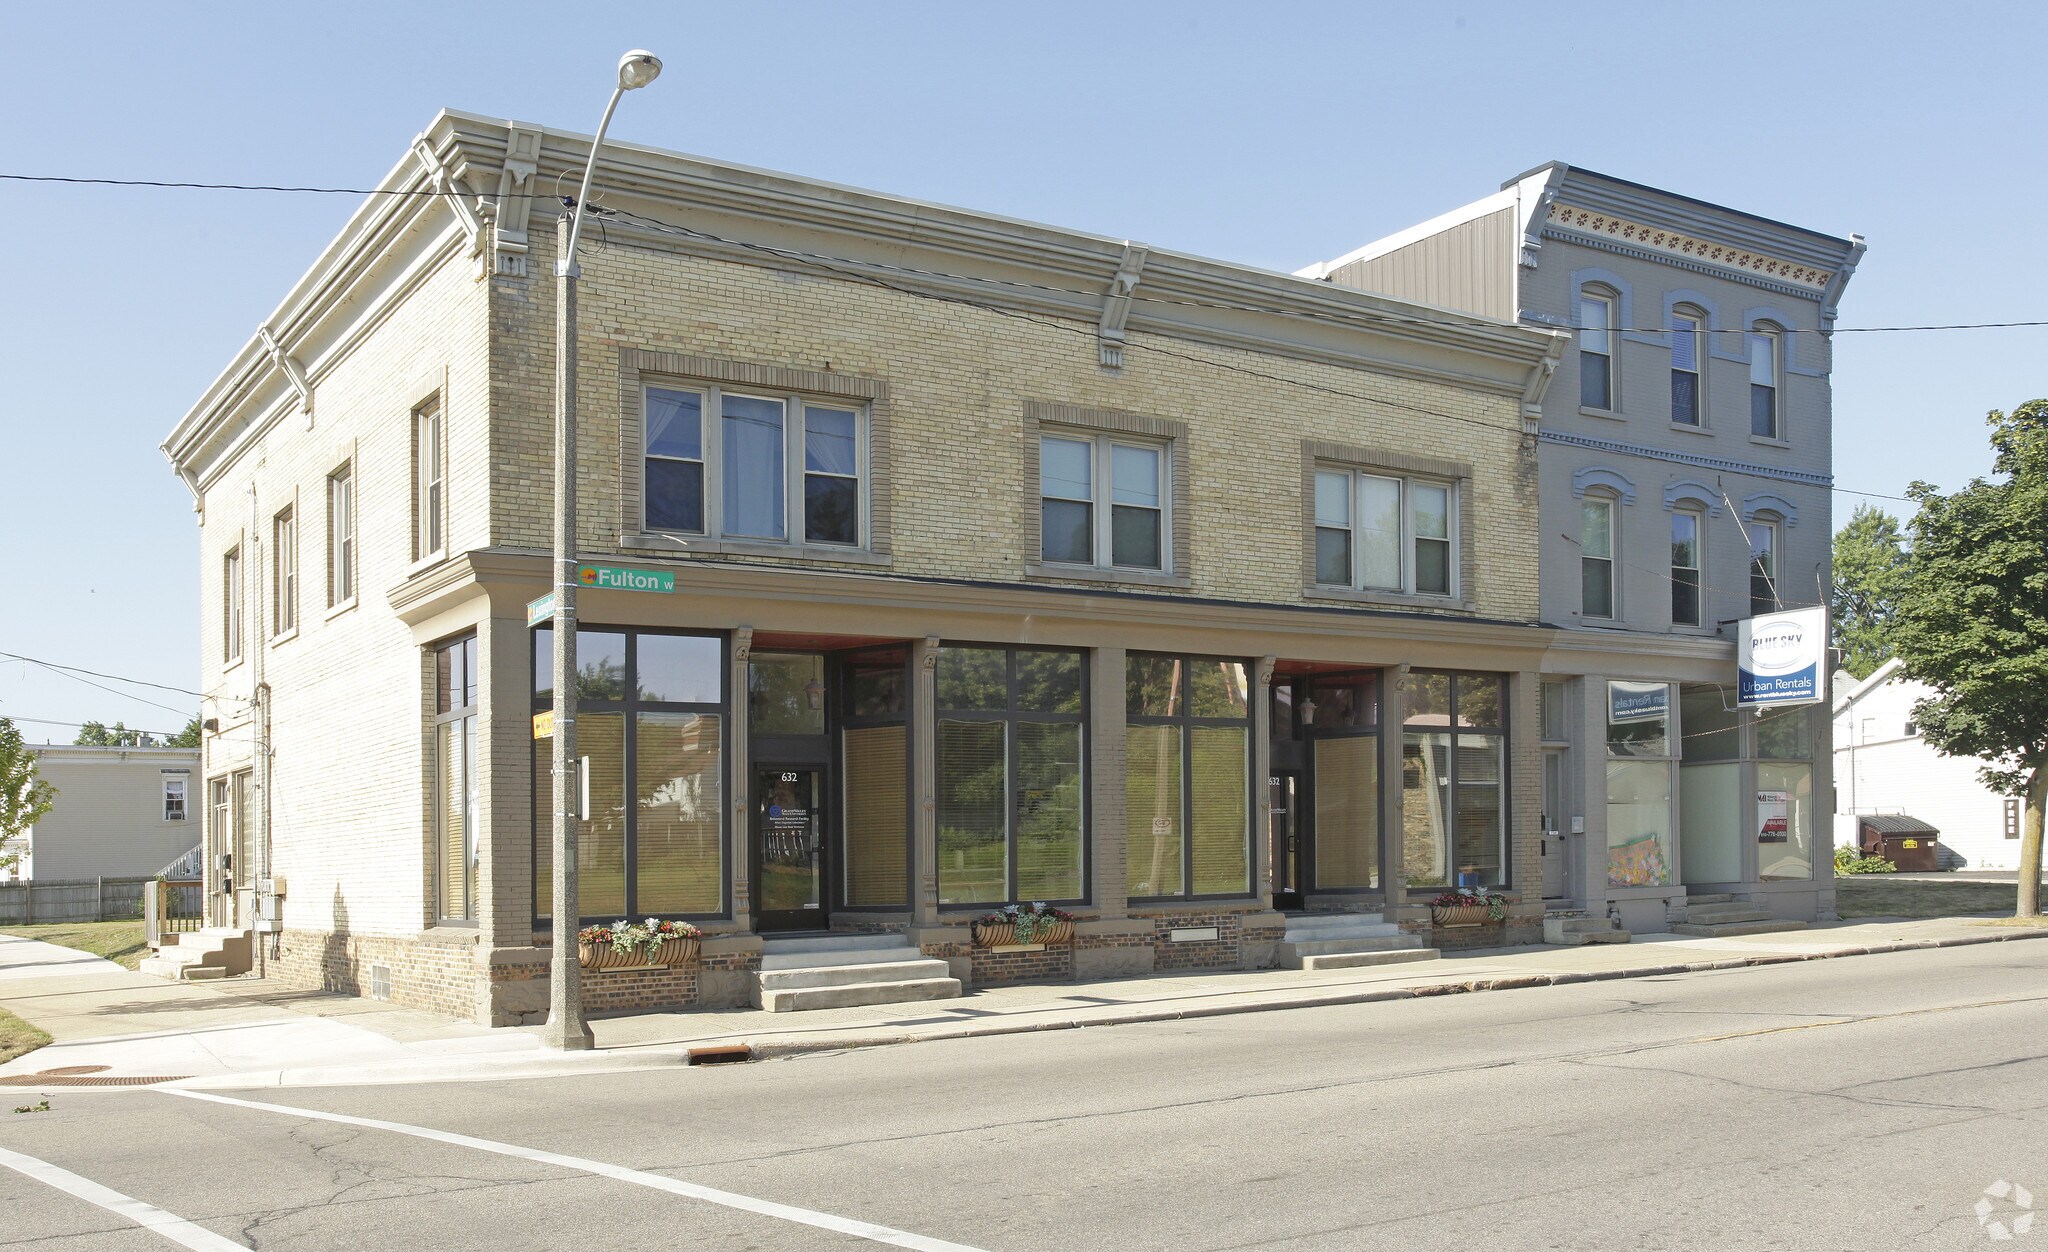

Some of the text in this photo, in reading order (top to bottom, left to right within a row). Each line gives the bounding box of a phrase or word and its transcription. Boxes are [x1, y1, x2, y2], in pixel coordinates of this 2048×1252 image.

[599, 569, 659, 589] Fulton
[1752, 634, 1803, 651] BLUE SKY
[1743, 676, 1812, 692] Urban Rentals
[1743, 689, 1812, 699] www.rentbluesky.com
[781, 772, 798, 782] 632
[2007, 801, 2016, 834] FREE
